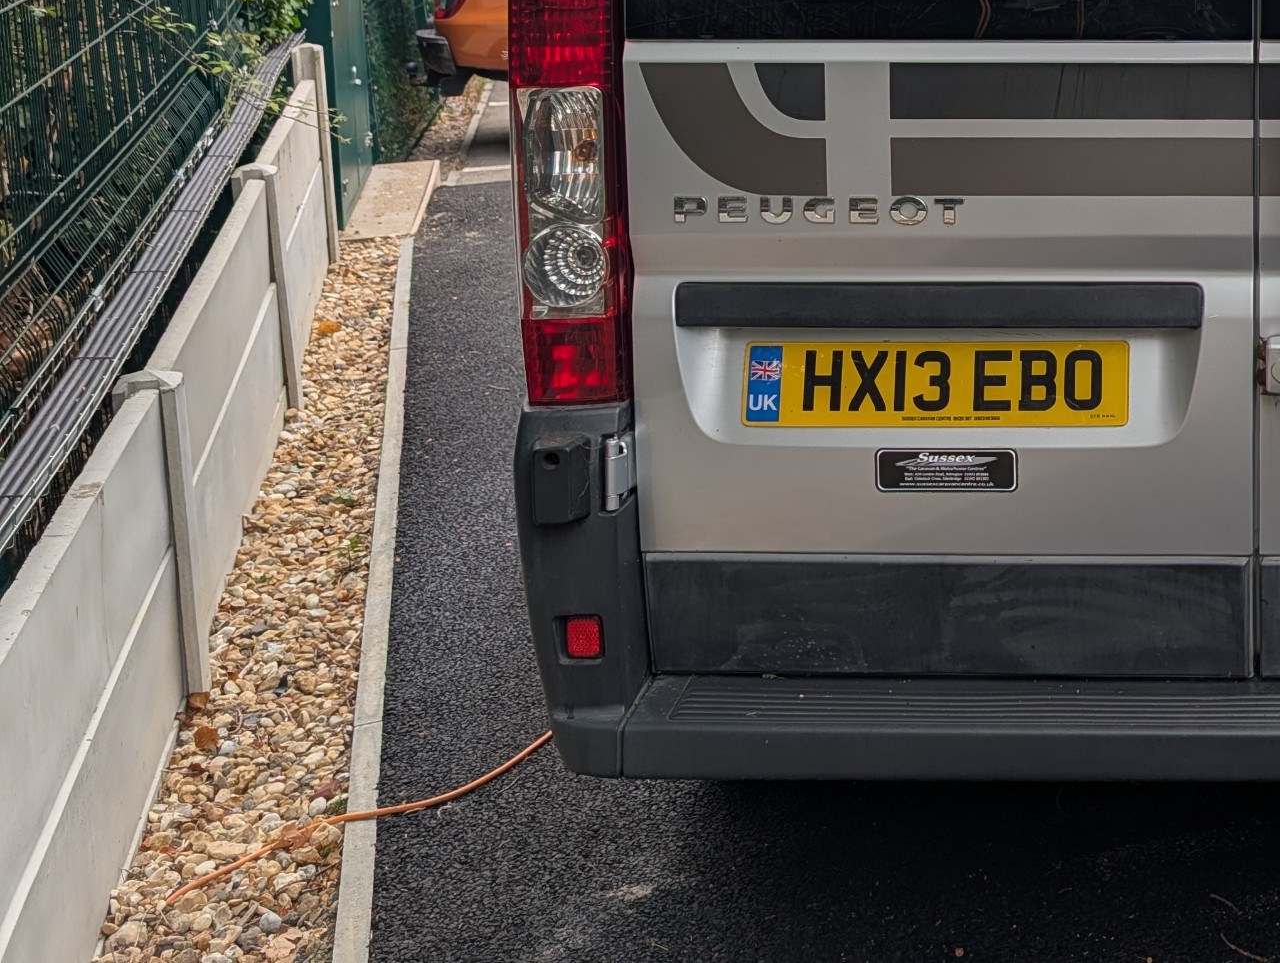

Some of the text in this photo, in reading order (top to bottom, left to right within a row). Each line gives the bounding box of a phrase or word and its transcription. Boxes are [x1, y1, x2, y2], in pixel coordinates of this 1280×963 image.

[673, 194, 966, 226] PEUGEOT
[802, 349, 1103, 412] HX13 EBO
[748, 393, 777, 411] UK
[917, 452, 976, 464] Sussex
